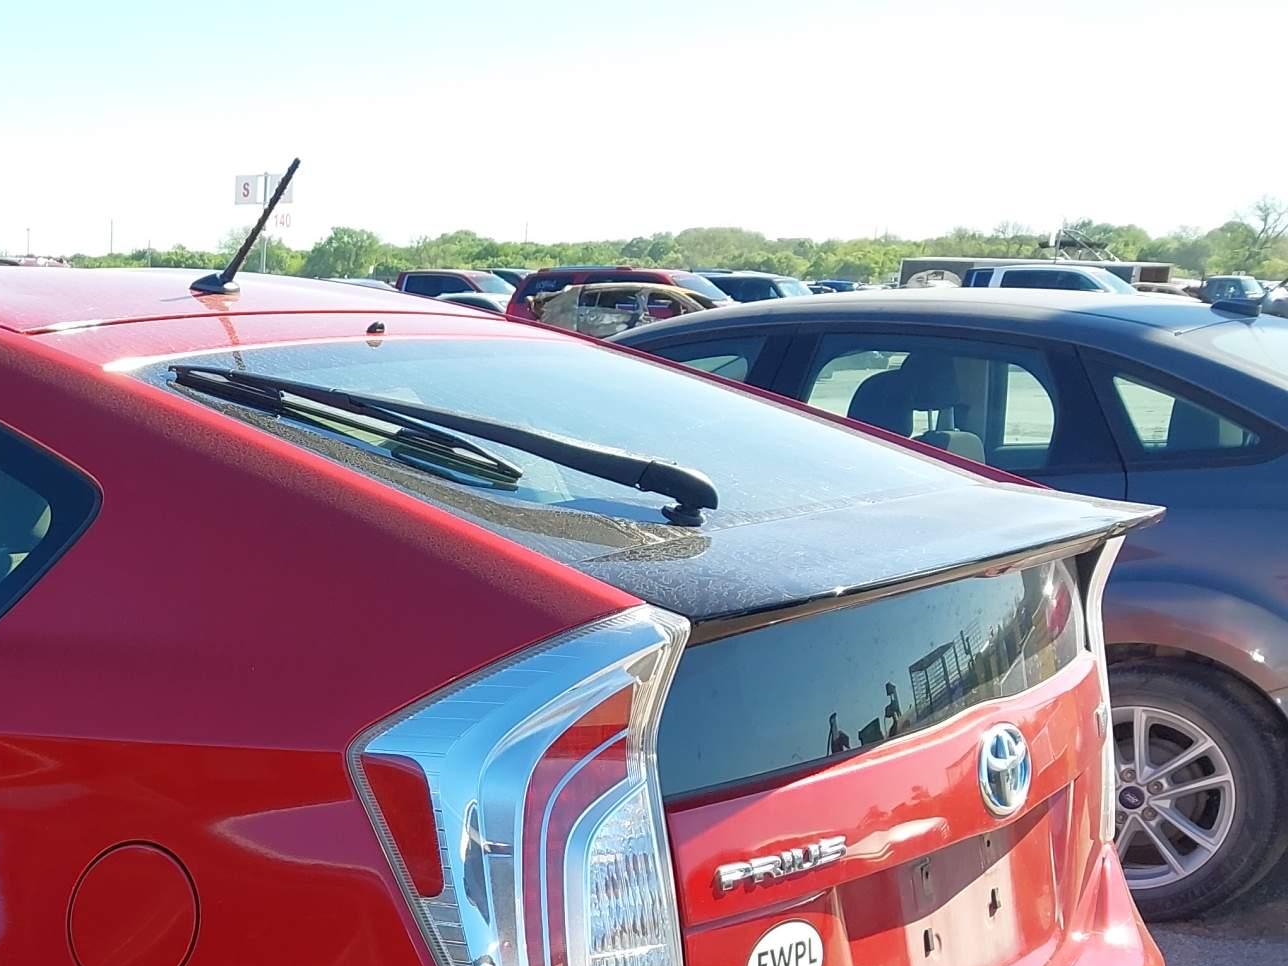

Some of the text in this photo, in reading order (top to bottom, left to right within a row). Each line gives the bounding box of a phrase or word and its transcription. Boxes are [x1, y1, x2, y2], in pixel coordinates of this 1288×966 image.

[242, 182, 250, 198] S
[274, 214, 292, 228] 140
[715, 835, 847, 891] PRIUS
